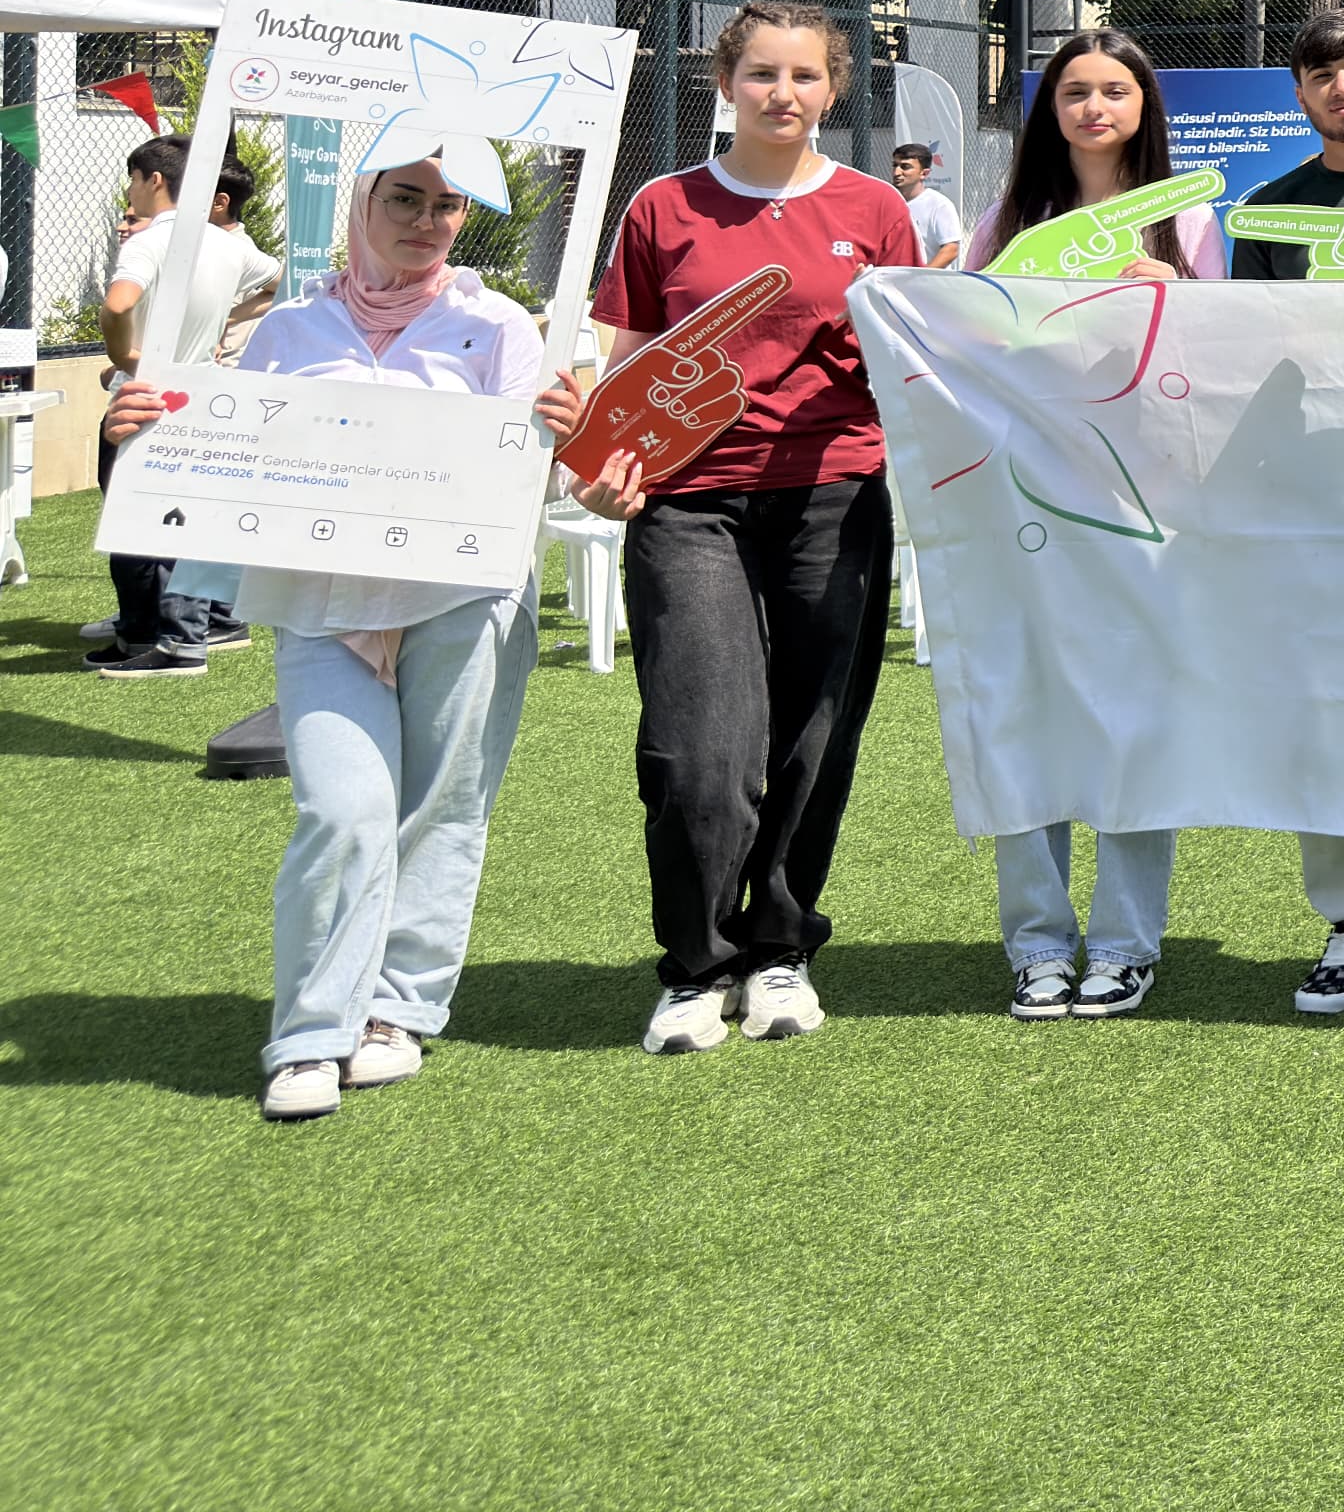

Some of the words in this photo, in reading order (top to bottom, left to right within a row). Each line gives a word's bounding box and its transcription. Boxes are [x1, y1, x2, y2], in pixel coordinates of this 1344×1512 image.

[255, 8, 403, 56] Instagram
[289, 70, 408, 94] seyyar_gencler
[1171, 111, 1216, 124] xüsusi
[1217, 110, 1307, 124] münasibətim
[1183, 126, 1247, 139] sizinlədir.
[1249, 126, 1269, 138] Siz
[1271, 125, 1312, 137] bütün
[1208, 141, 1270, 154] bilərsiniz.
[153, 423, 188, 437] 2026
[191, 426, 260, 446] bəyənmə
[143, 459, 182, 474] #Azgf
[190, 464, 255, 479] #SGX2026
[263, 470, 350, 488] #Gənckönüllü
[148, 443, 259, 465] seyyar_gencler
[385, 467, 420, 482] üçün
[423, 470, 437, 482] 15
